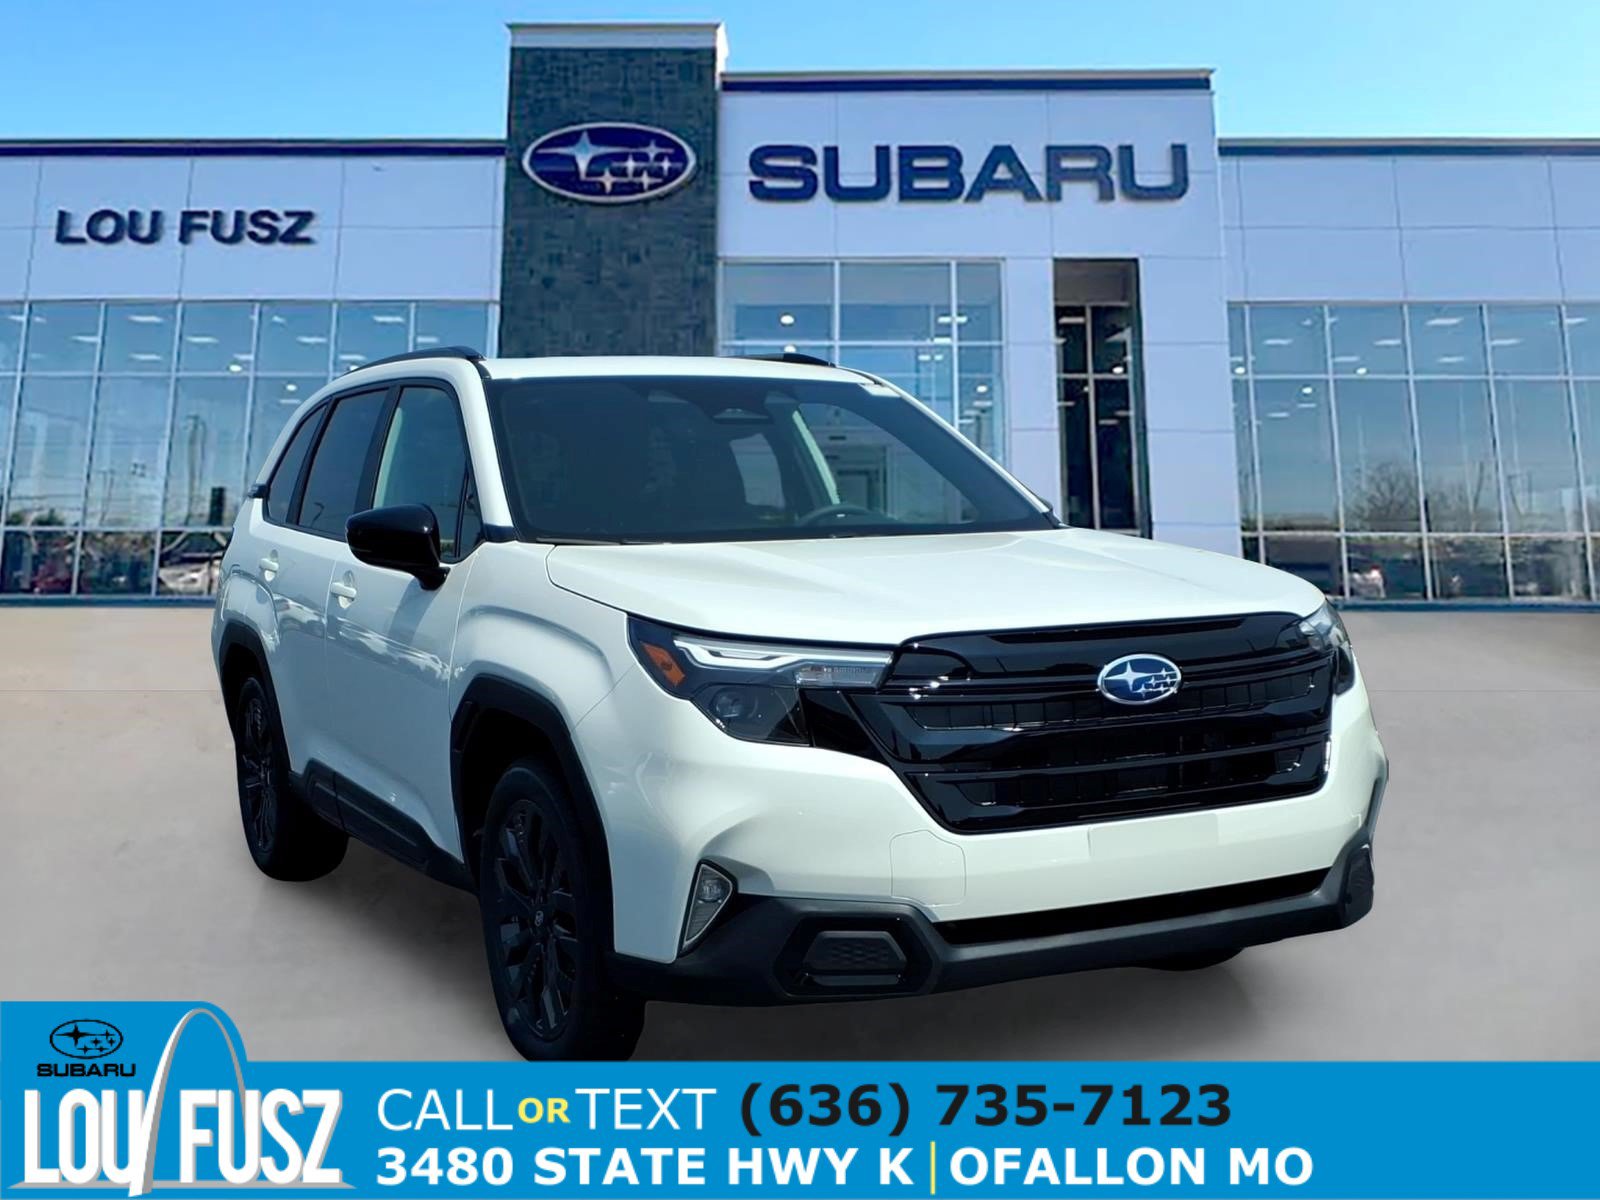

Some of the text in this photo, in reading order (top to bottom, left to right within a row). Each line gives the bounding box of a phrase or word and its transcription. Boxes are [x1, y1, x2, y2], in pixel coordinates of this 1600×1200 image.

[748, 143, 1190, 203] SUBARU
[55, 209, 316, 245] LOU FUSZ
